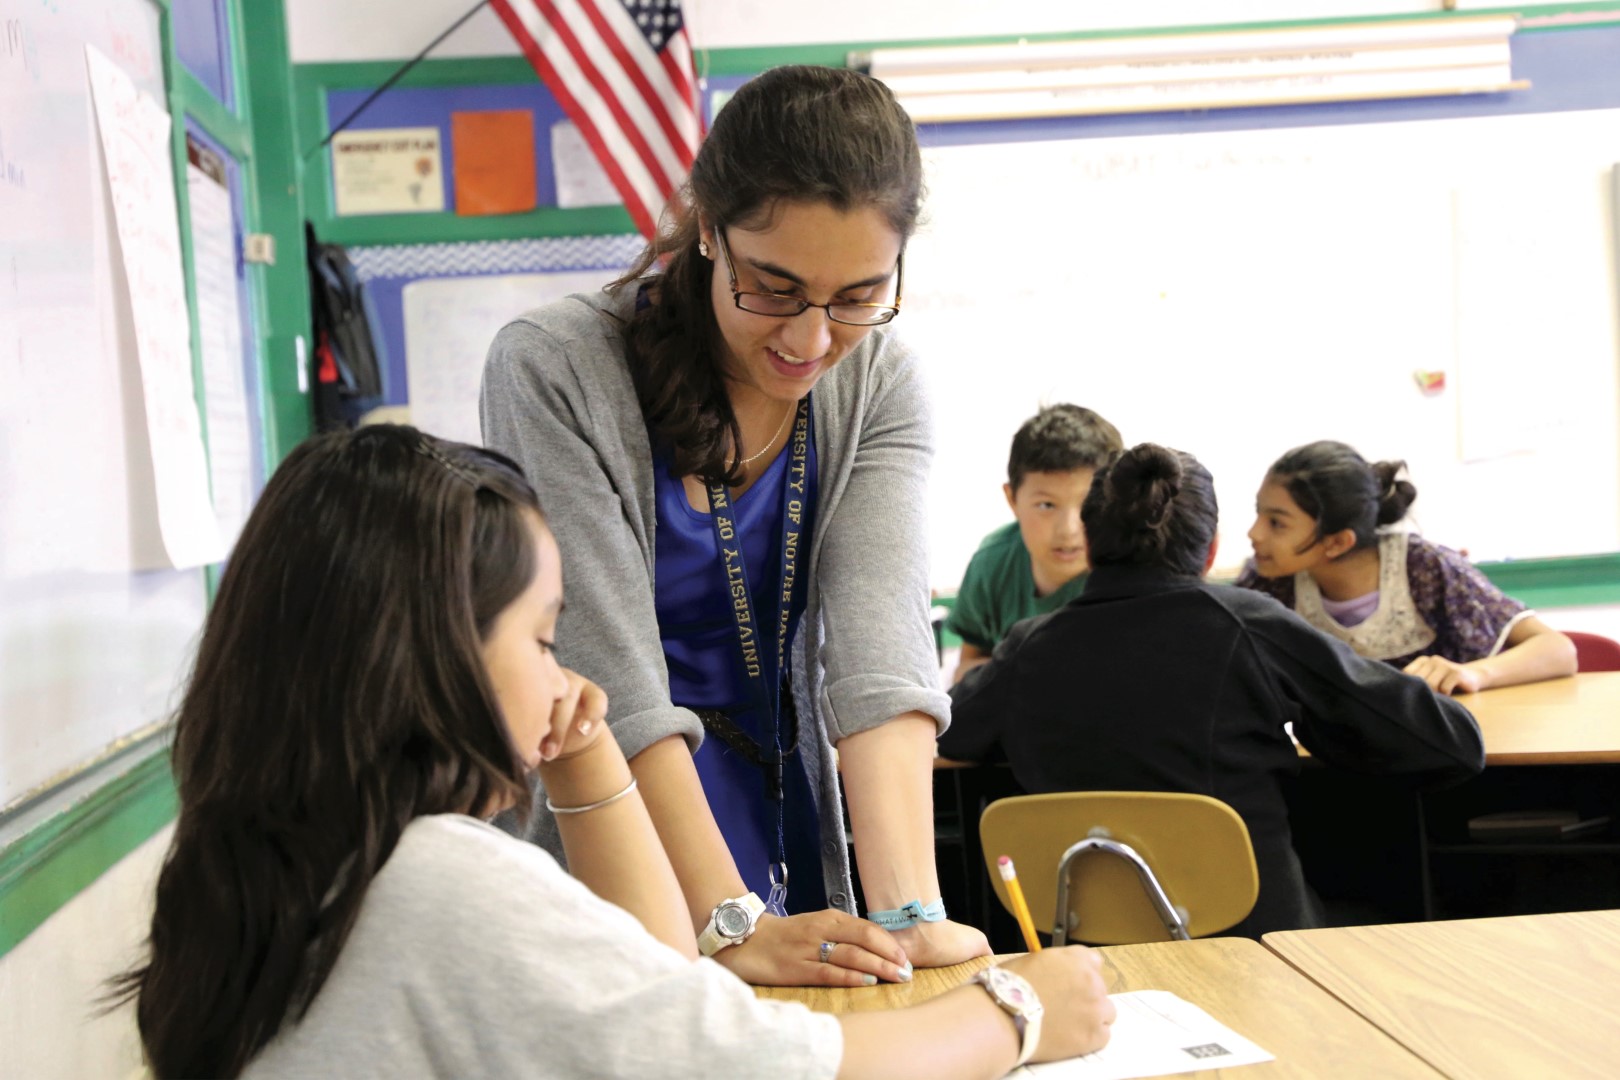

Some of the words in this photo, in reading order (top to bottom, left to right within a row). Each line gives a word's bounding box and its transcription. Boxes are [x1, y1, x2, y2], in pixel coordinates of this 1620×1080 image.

[717, 516, 734, 540] OF
[788, 500, 802, 525] OF
[782, 531, 799, 602] NOTRE
[723, 548, 760, 677] UNIVERSITY
[777, 610, 790, 668] DAME
